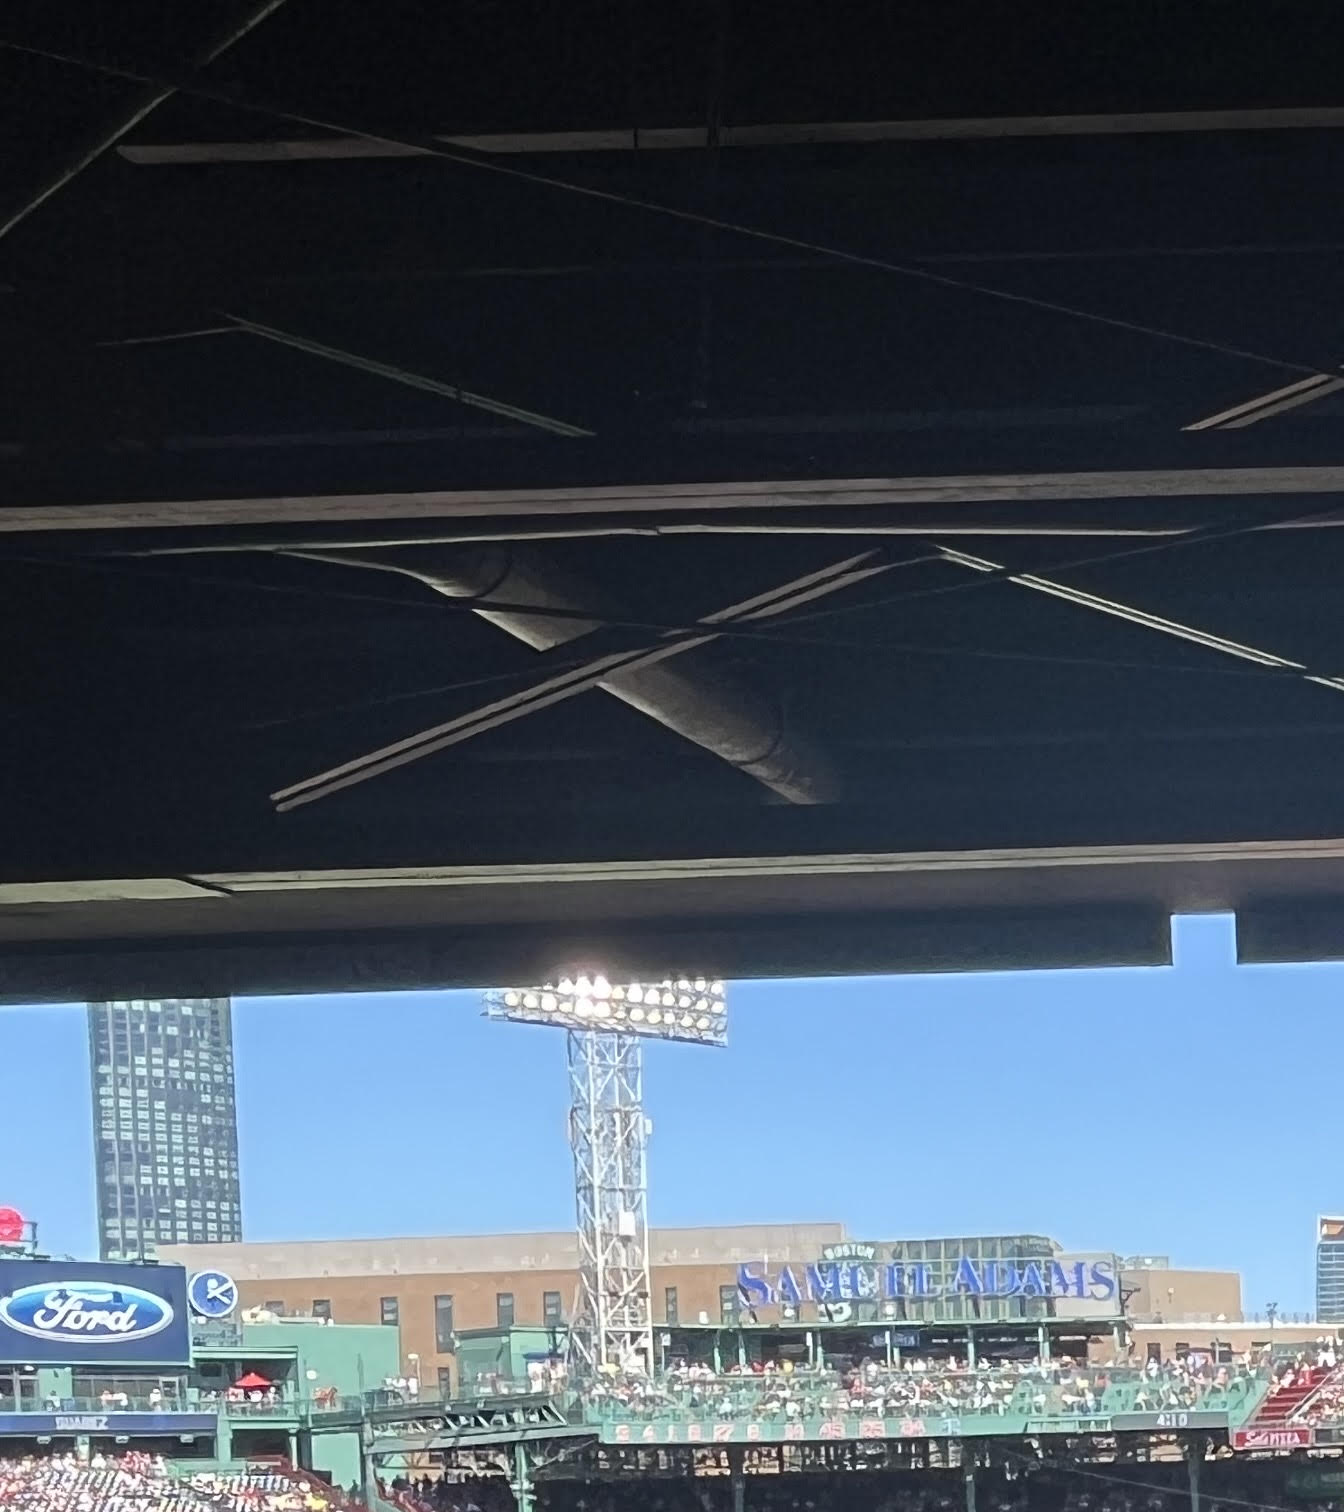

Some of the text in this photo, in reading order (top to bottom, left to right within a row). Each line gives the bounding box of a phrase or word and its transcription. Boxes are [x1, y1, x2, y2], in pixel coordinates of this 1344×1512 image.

[737, 1261, 944, 1306] SAMUEL
[952, 1255, 1118, 1301] ADAMS
[33, 1289, 138, 1332] Ford
